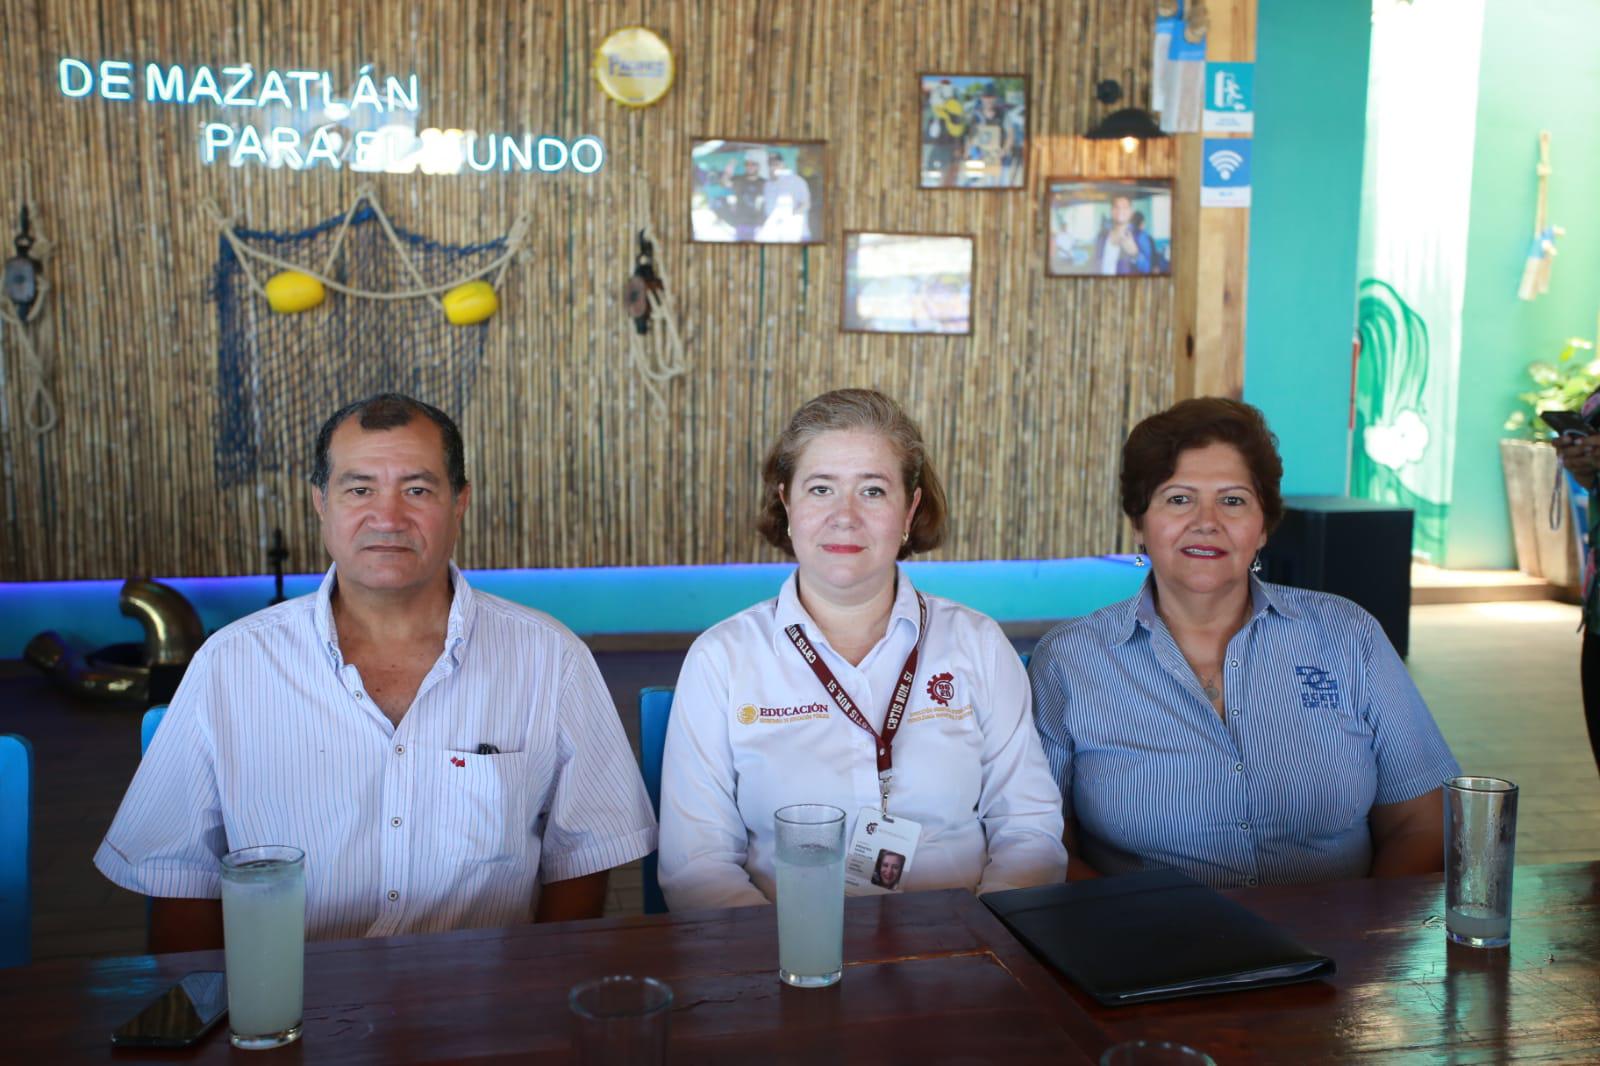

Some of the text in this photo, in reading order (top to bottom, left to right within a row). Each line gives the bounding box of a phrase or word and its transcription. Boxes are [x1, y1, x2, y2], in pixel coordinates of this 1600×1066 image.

[59, 58, 418, 112] DE MAZATLÁN
[204, 122, 340, 169] PARA
[795, 638, 817, 664] CBTIS
[759, 702, 828, 717] EDUCACIÓN
[887, 703, 904, 730] CBTIS
